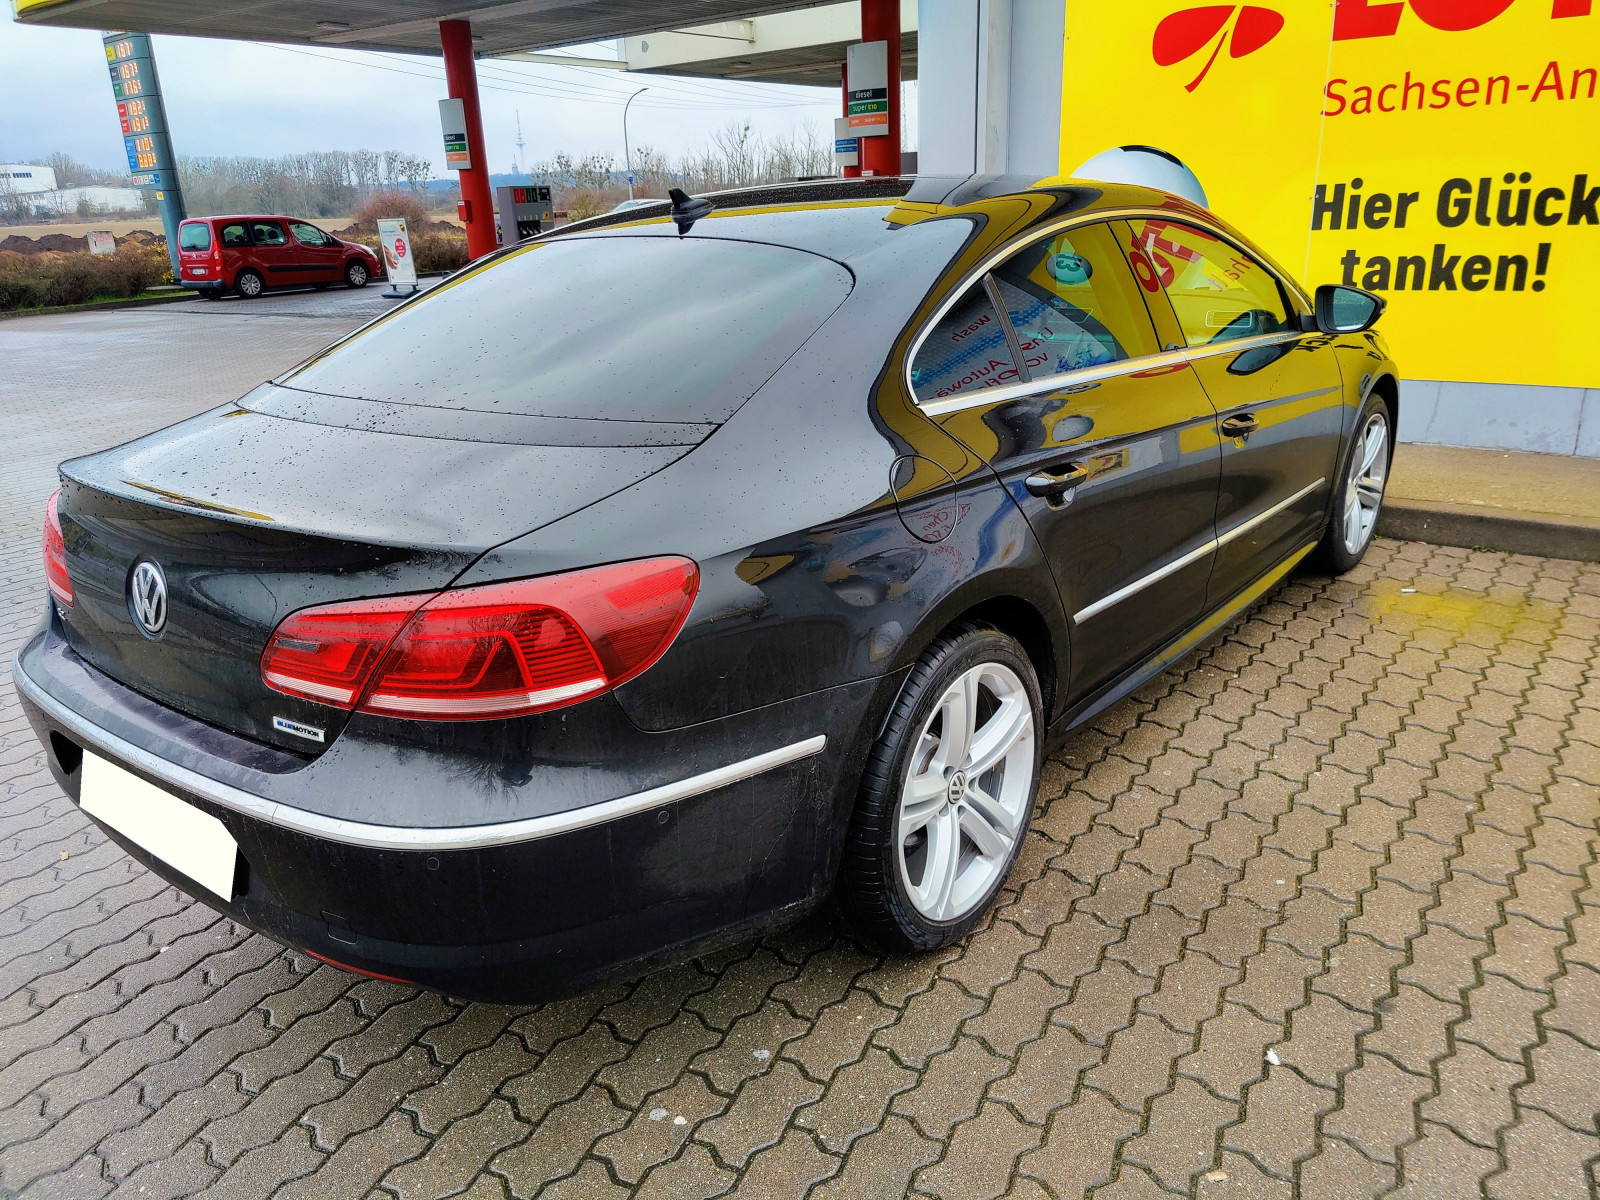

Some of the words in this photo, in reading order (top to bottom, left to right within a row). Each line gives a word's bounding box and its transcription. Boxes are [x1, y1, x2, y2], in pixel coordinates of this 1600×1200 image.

[855, 90, 873, 99] diesel
[852, 104, 867, 112] super
[1311, 177, 1420, 231] Hier
[1436, 171, 1600, 228] Glück
[1340, 242, 1552, 292] tanken!
[276, 719, 320, 738] BLUEMOTION
